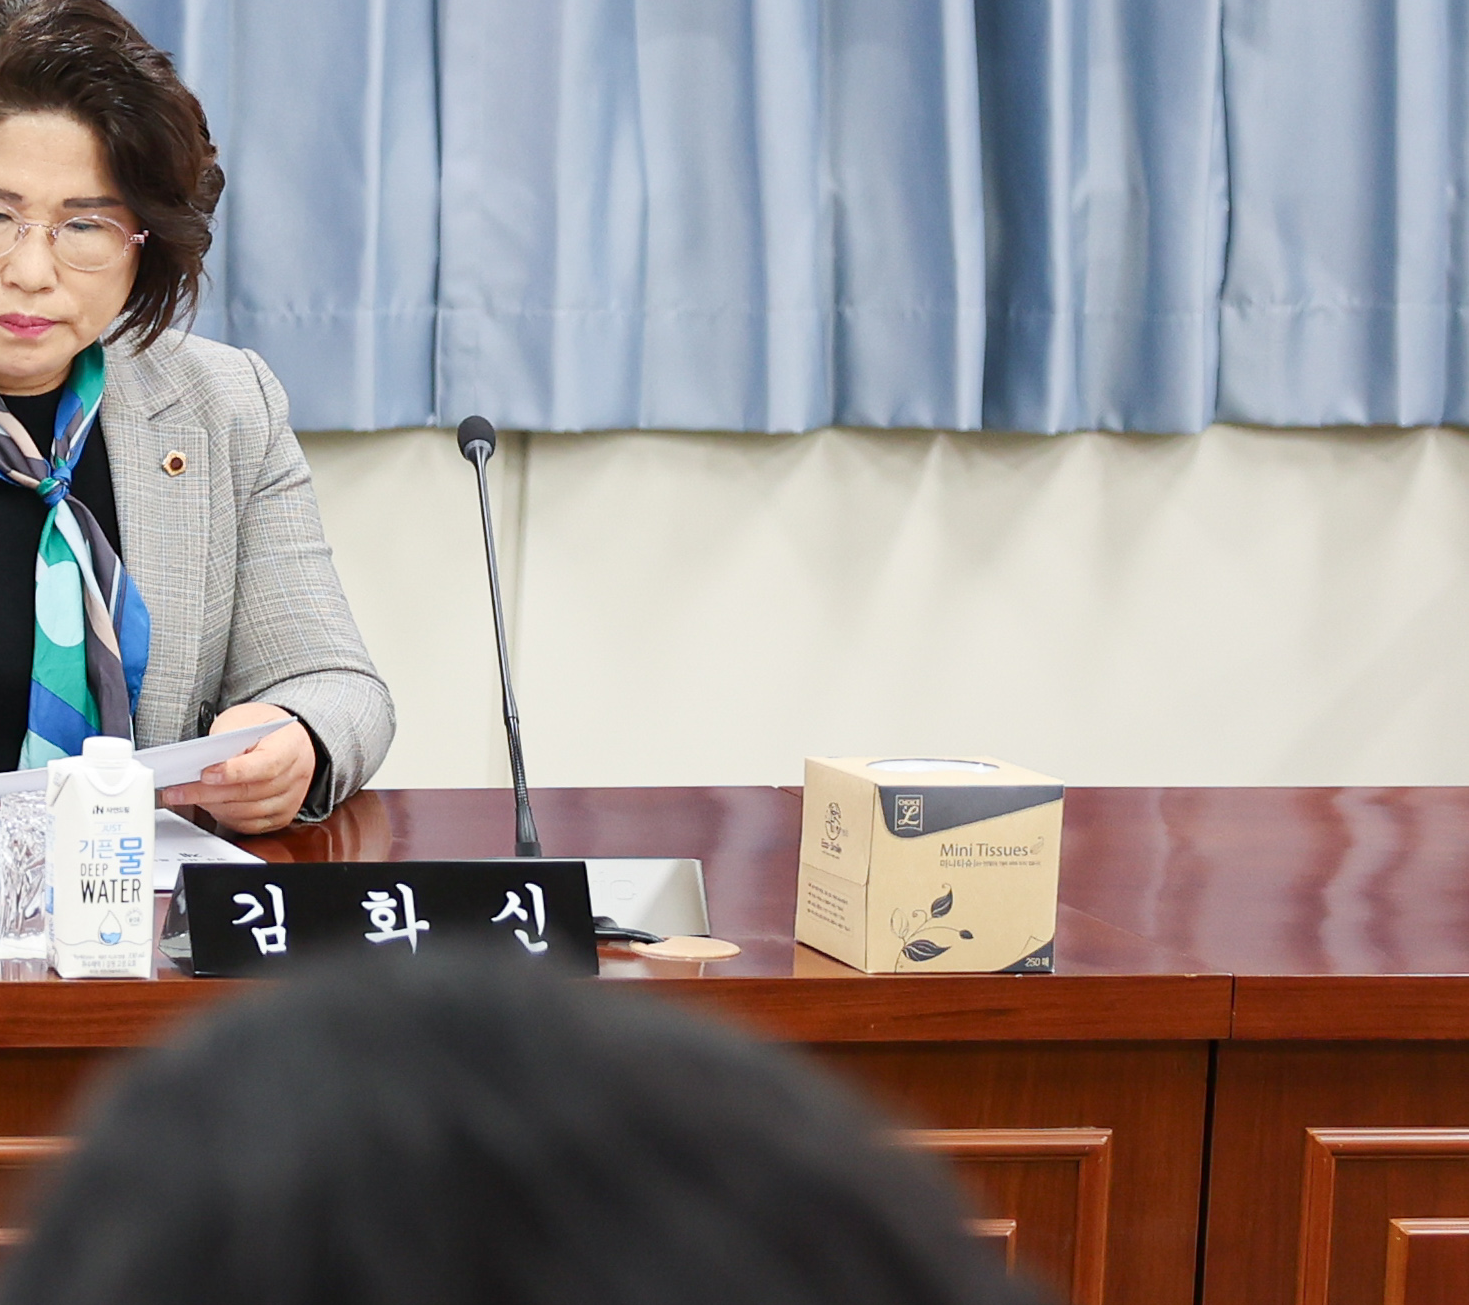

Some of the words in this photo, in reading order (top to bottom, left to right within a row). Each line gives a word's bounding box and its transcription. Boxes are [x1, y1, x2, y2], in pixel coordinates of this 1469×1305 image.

[102, 824, 122, 832] JUST
[940, 842, 973, 857] Mini
[976, 842, 1029, 857] Tissues
[80, 863, 109, 877] DEEP
[81, 878, 142, 904] WATER
